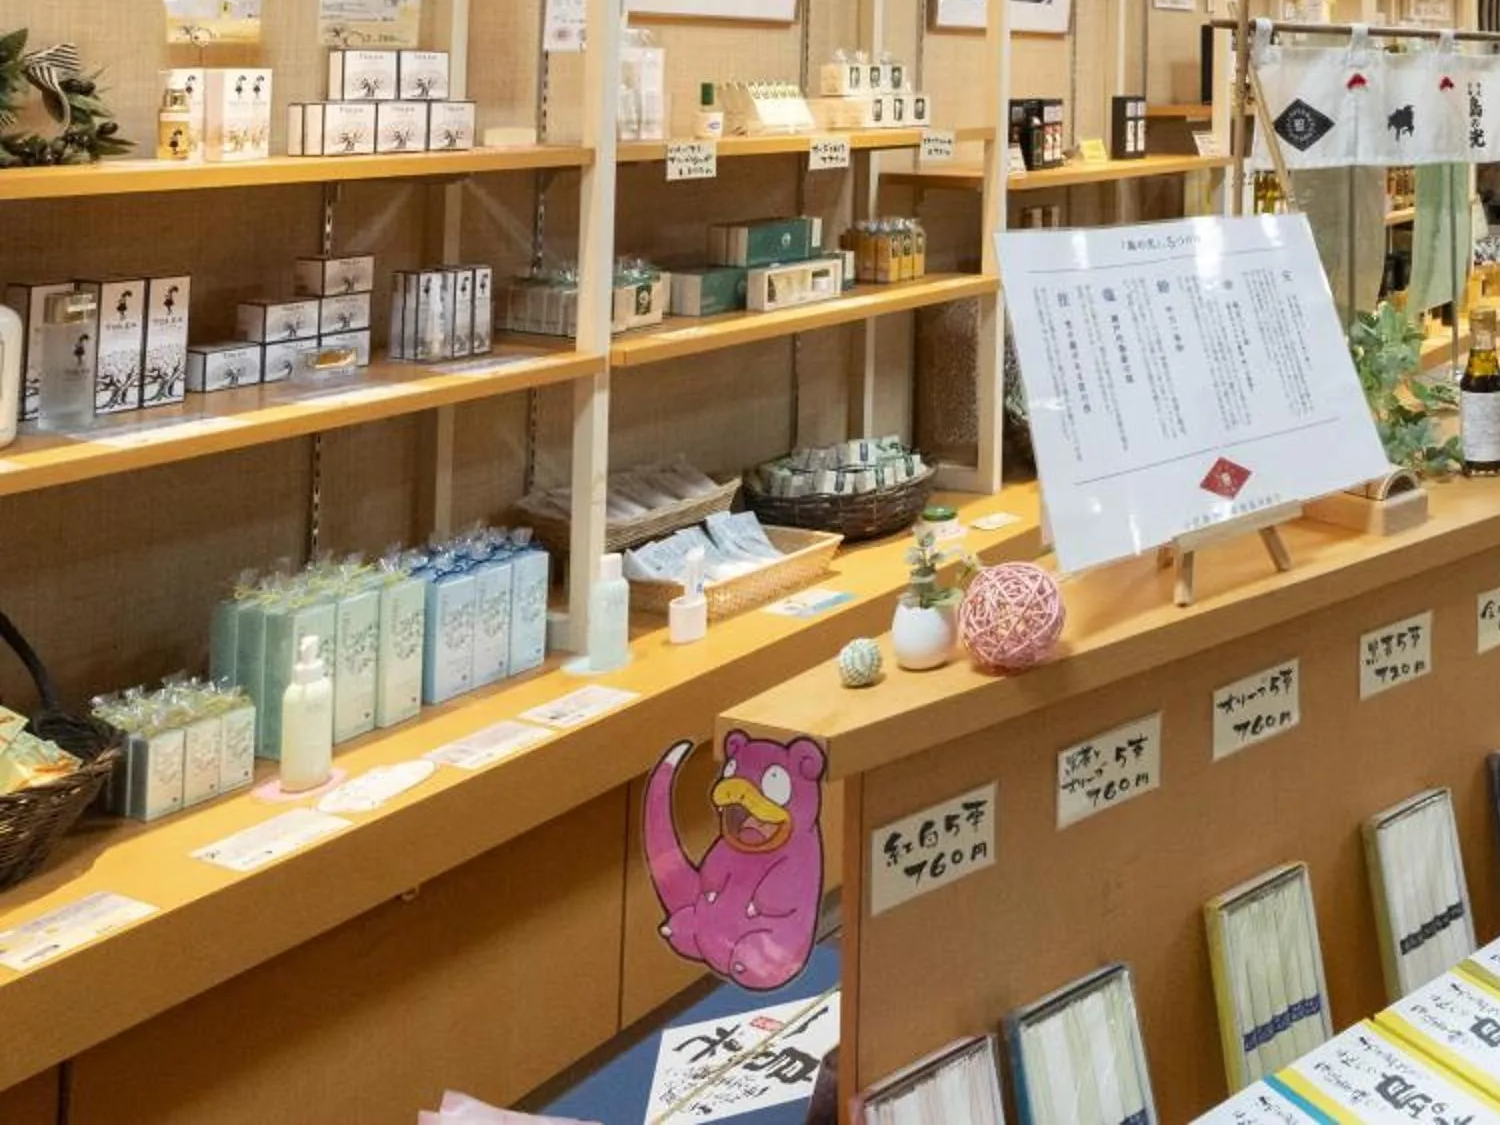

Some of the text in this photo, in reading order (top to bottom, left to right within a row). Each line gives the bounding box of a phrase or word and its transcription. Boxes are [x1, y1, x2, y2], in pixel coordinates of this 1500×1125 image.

[1469, 96, 1486, 148] 島の光
[1231, 710, 1293, 741] 760円
[1086, 773, 1149, 807] 760円
[904, 840, 988, 894] 760円
